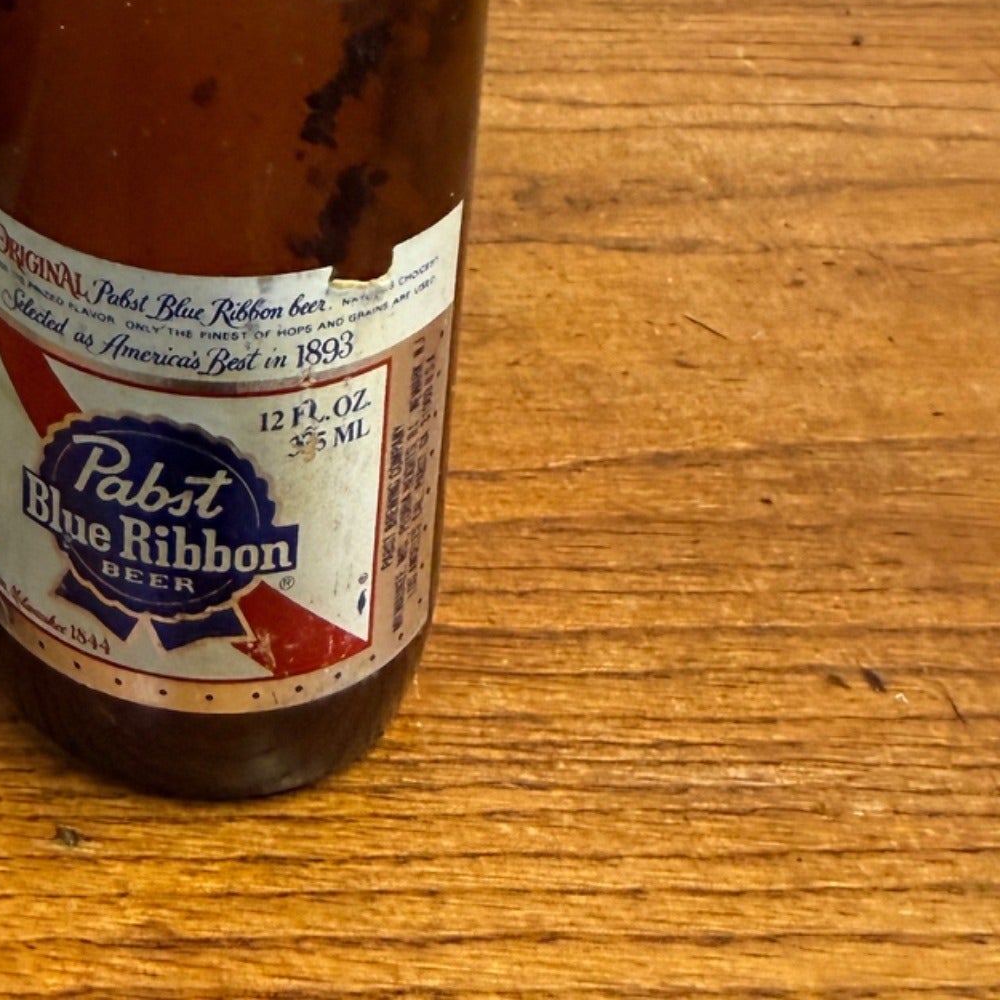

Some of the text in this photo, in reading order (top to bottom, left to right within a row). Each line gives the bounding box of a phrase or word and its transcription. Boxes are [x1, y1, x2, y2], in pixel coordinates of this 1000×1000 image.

[68, 301, 116, 325] FLAVOR
[125, 320, 161, 335] ONLY
[167, 327, 193, 339] THE
[277, 324, 312, 337] HOPS
[317, 316, 345, 331] AND
[88, 278, 149, 314] Pabst
[146, 293, 206, 322] Blue
[203, 297, 282, 330] Ribbon
[2, 287, 354, 377] Selected as America's Best in 1893
[260, 410, 284, 433] 12
[333, 417, 371, 447] ML
[72, 434, 233, 519] Pabst
[26, 471, 112, 552] Blue
[119, 513, 293, 573] Ribbon
[102, 558, 195, 594] BEER
[70, 624, 112, 656] 1844
